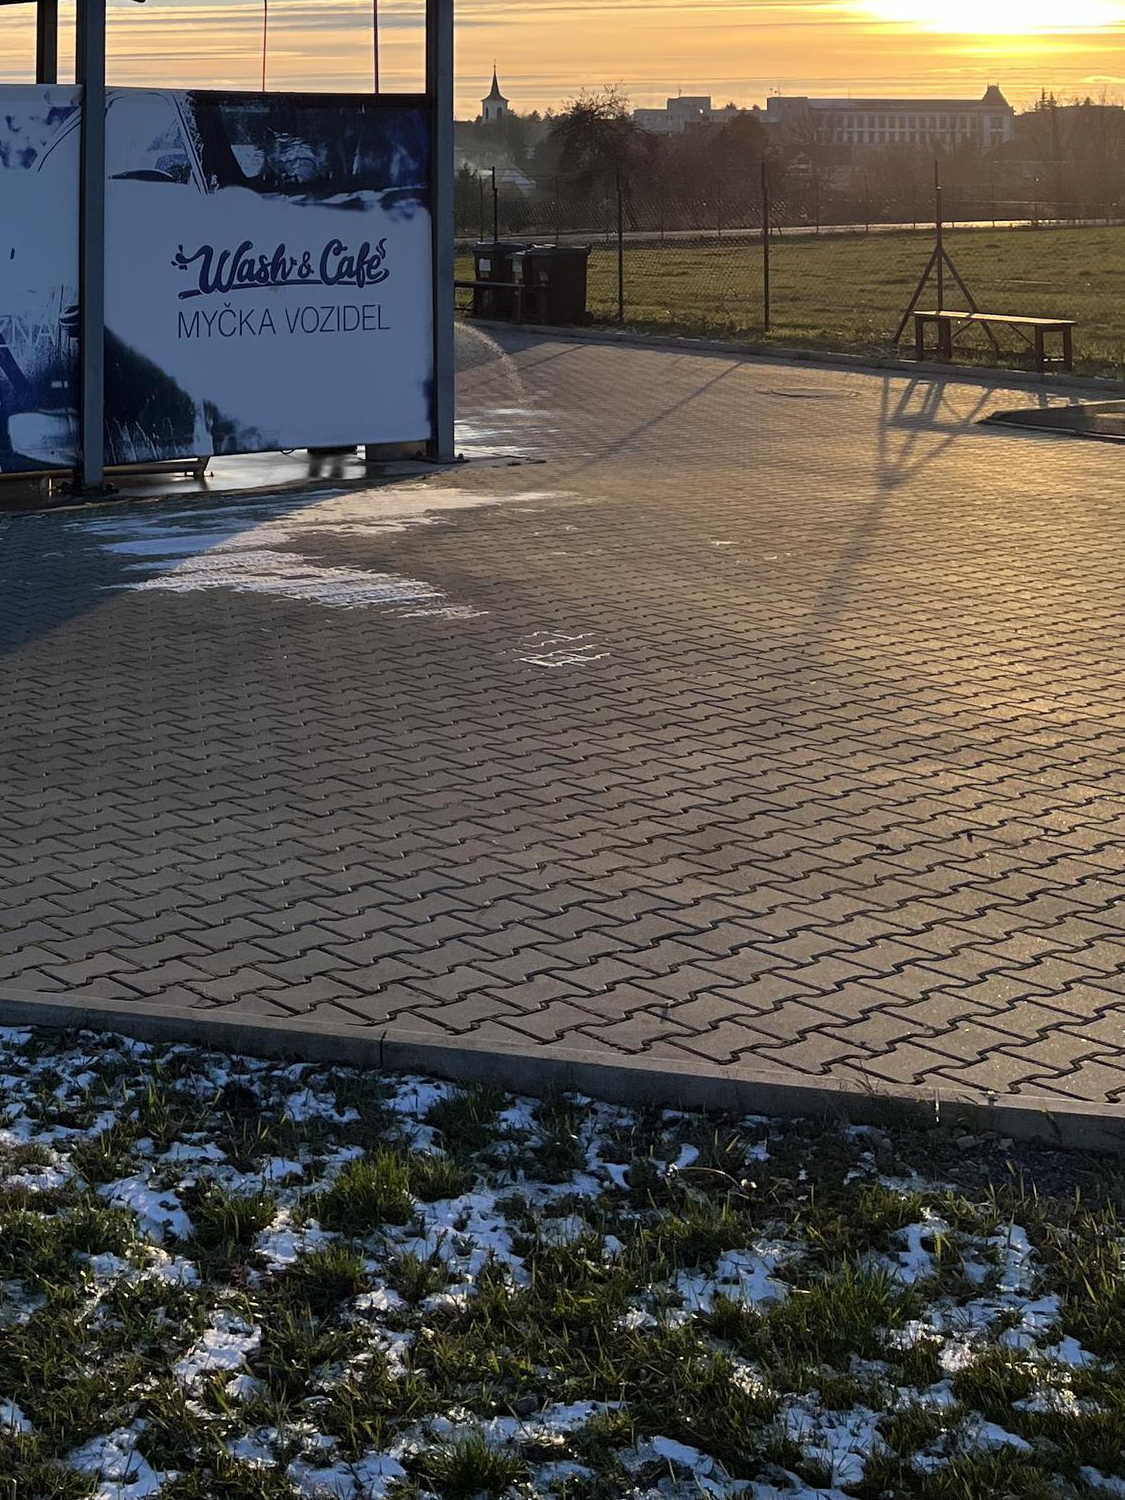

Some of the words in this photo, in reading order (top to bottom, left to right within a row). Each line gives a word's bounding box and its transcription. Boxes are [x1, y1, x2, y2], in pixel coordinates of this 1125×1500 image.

[176, 240, 293, 293] Wash
[297, 251, 314, 279] &
[178, 302, 276, 339] MYČKA
[285, 304, 391, 335] VOZIDEL
